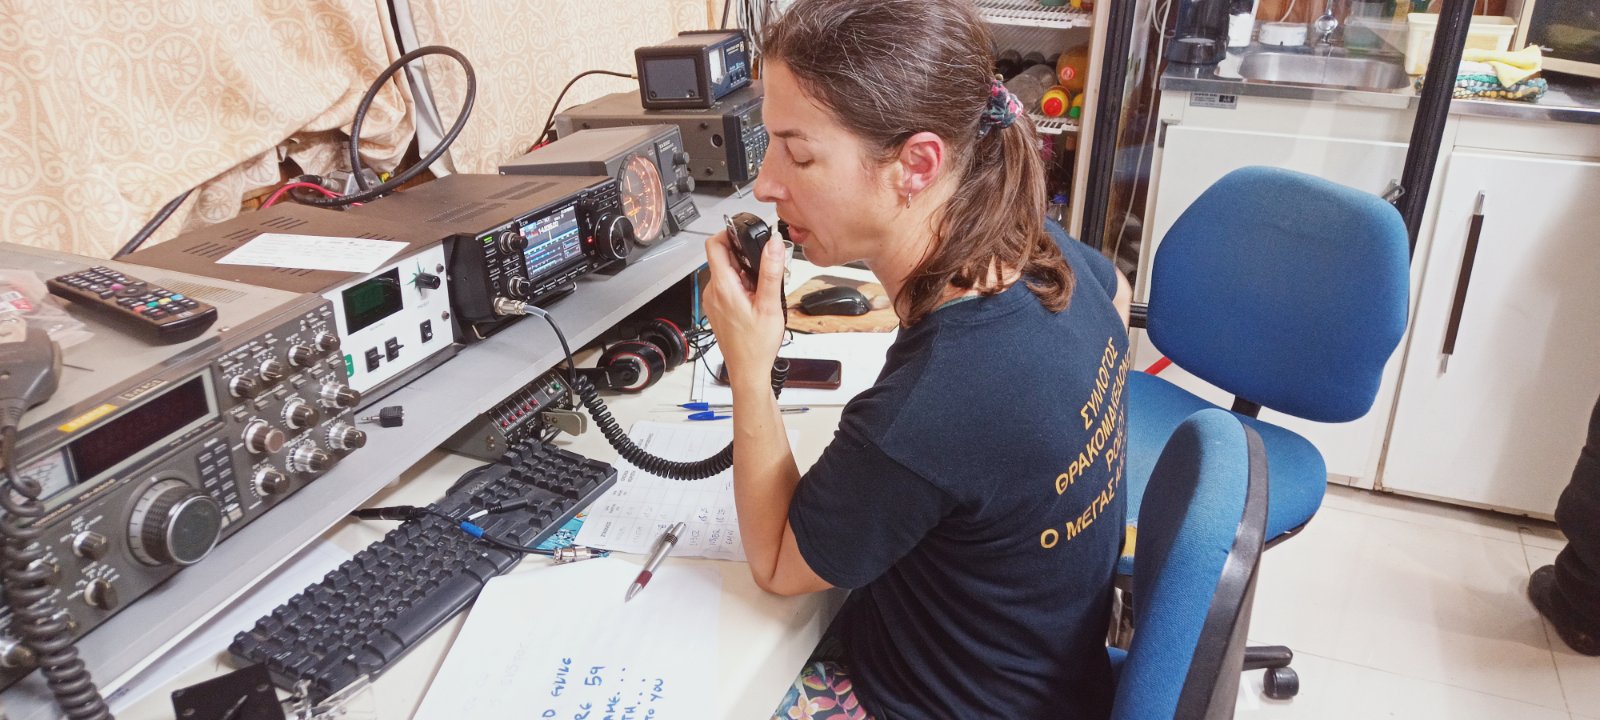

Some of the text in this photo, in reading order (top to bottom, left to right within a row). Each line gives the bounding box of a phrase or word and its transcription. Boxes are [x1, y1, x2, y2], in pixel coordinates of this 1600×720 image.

[1080, 336, 1119, 431] ΣΥΛΛΟΓΟΣ
[1040, 477, 1116, 549] Ο ΜΕΓΑΣ
[584, 666, 606, 686] 59
[650, 678, 664, 702] YOU
